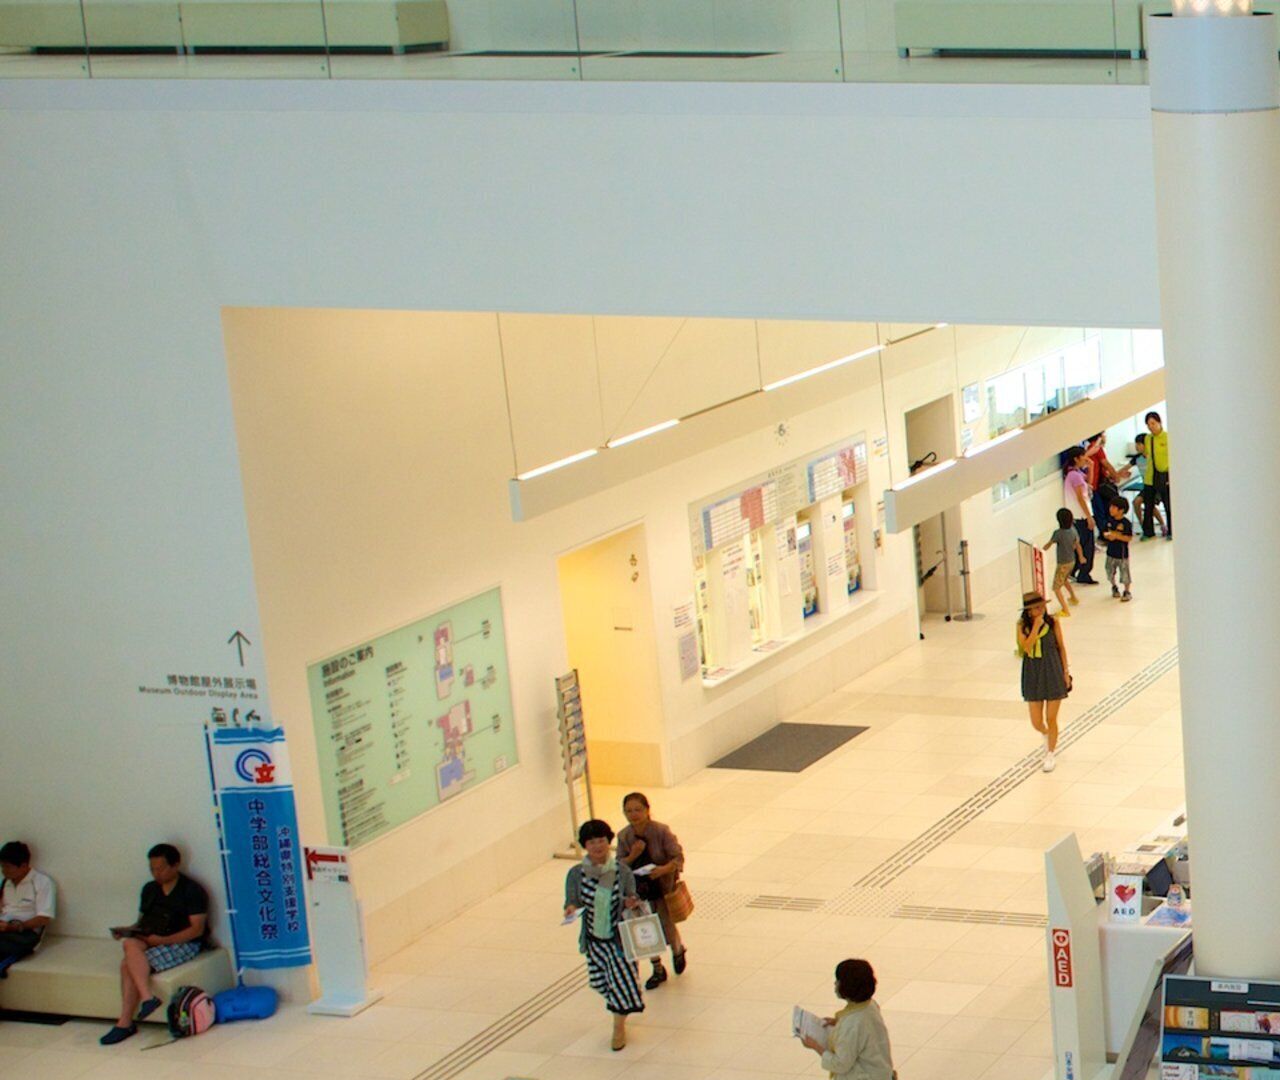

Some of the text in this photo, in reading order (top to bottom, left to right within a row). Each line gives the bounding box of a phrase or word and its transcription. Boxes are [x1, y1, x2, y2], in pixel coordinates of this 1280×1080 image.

[166, 674, 257, 690] 博物館屋外展示場
[138, 685, 258, 699] Museum Outdoor Display Area
[248, 798, 280, 940] 中学部総合文化祭
[1113, 907, 1136, 916] AED
[1055, 950, 1071, 986] AED
